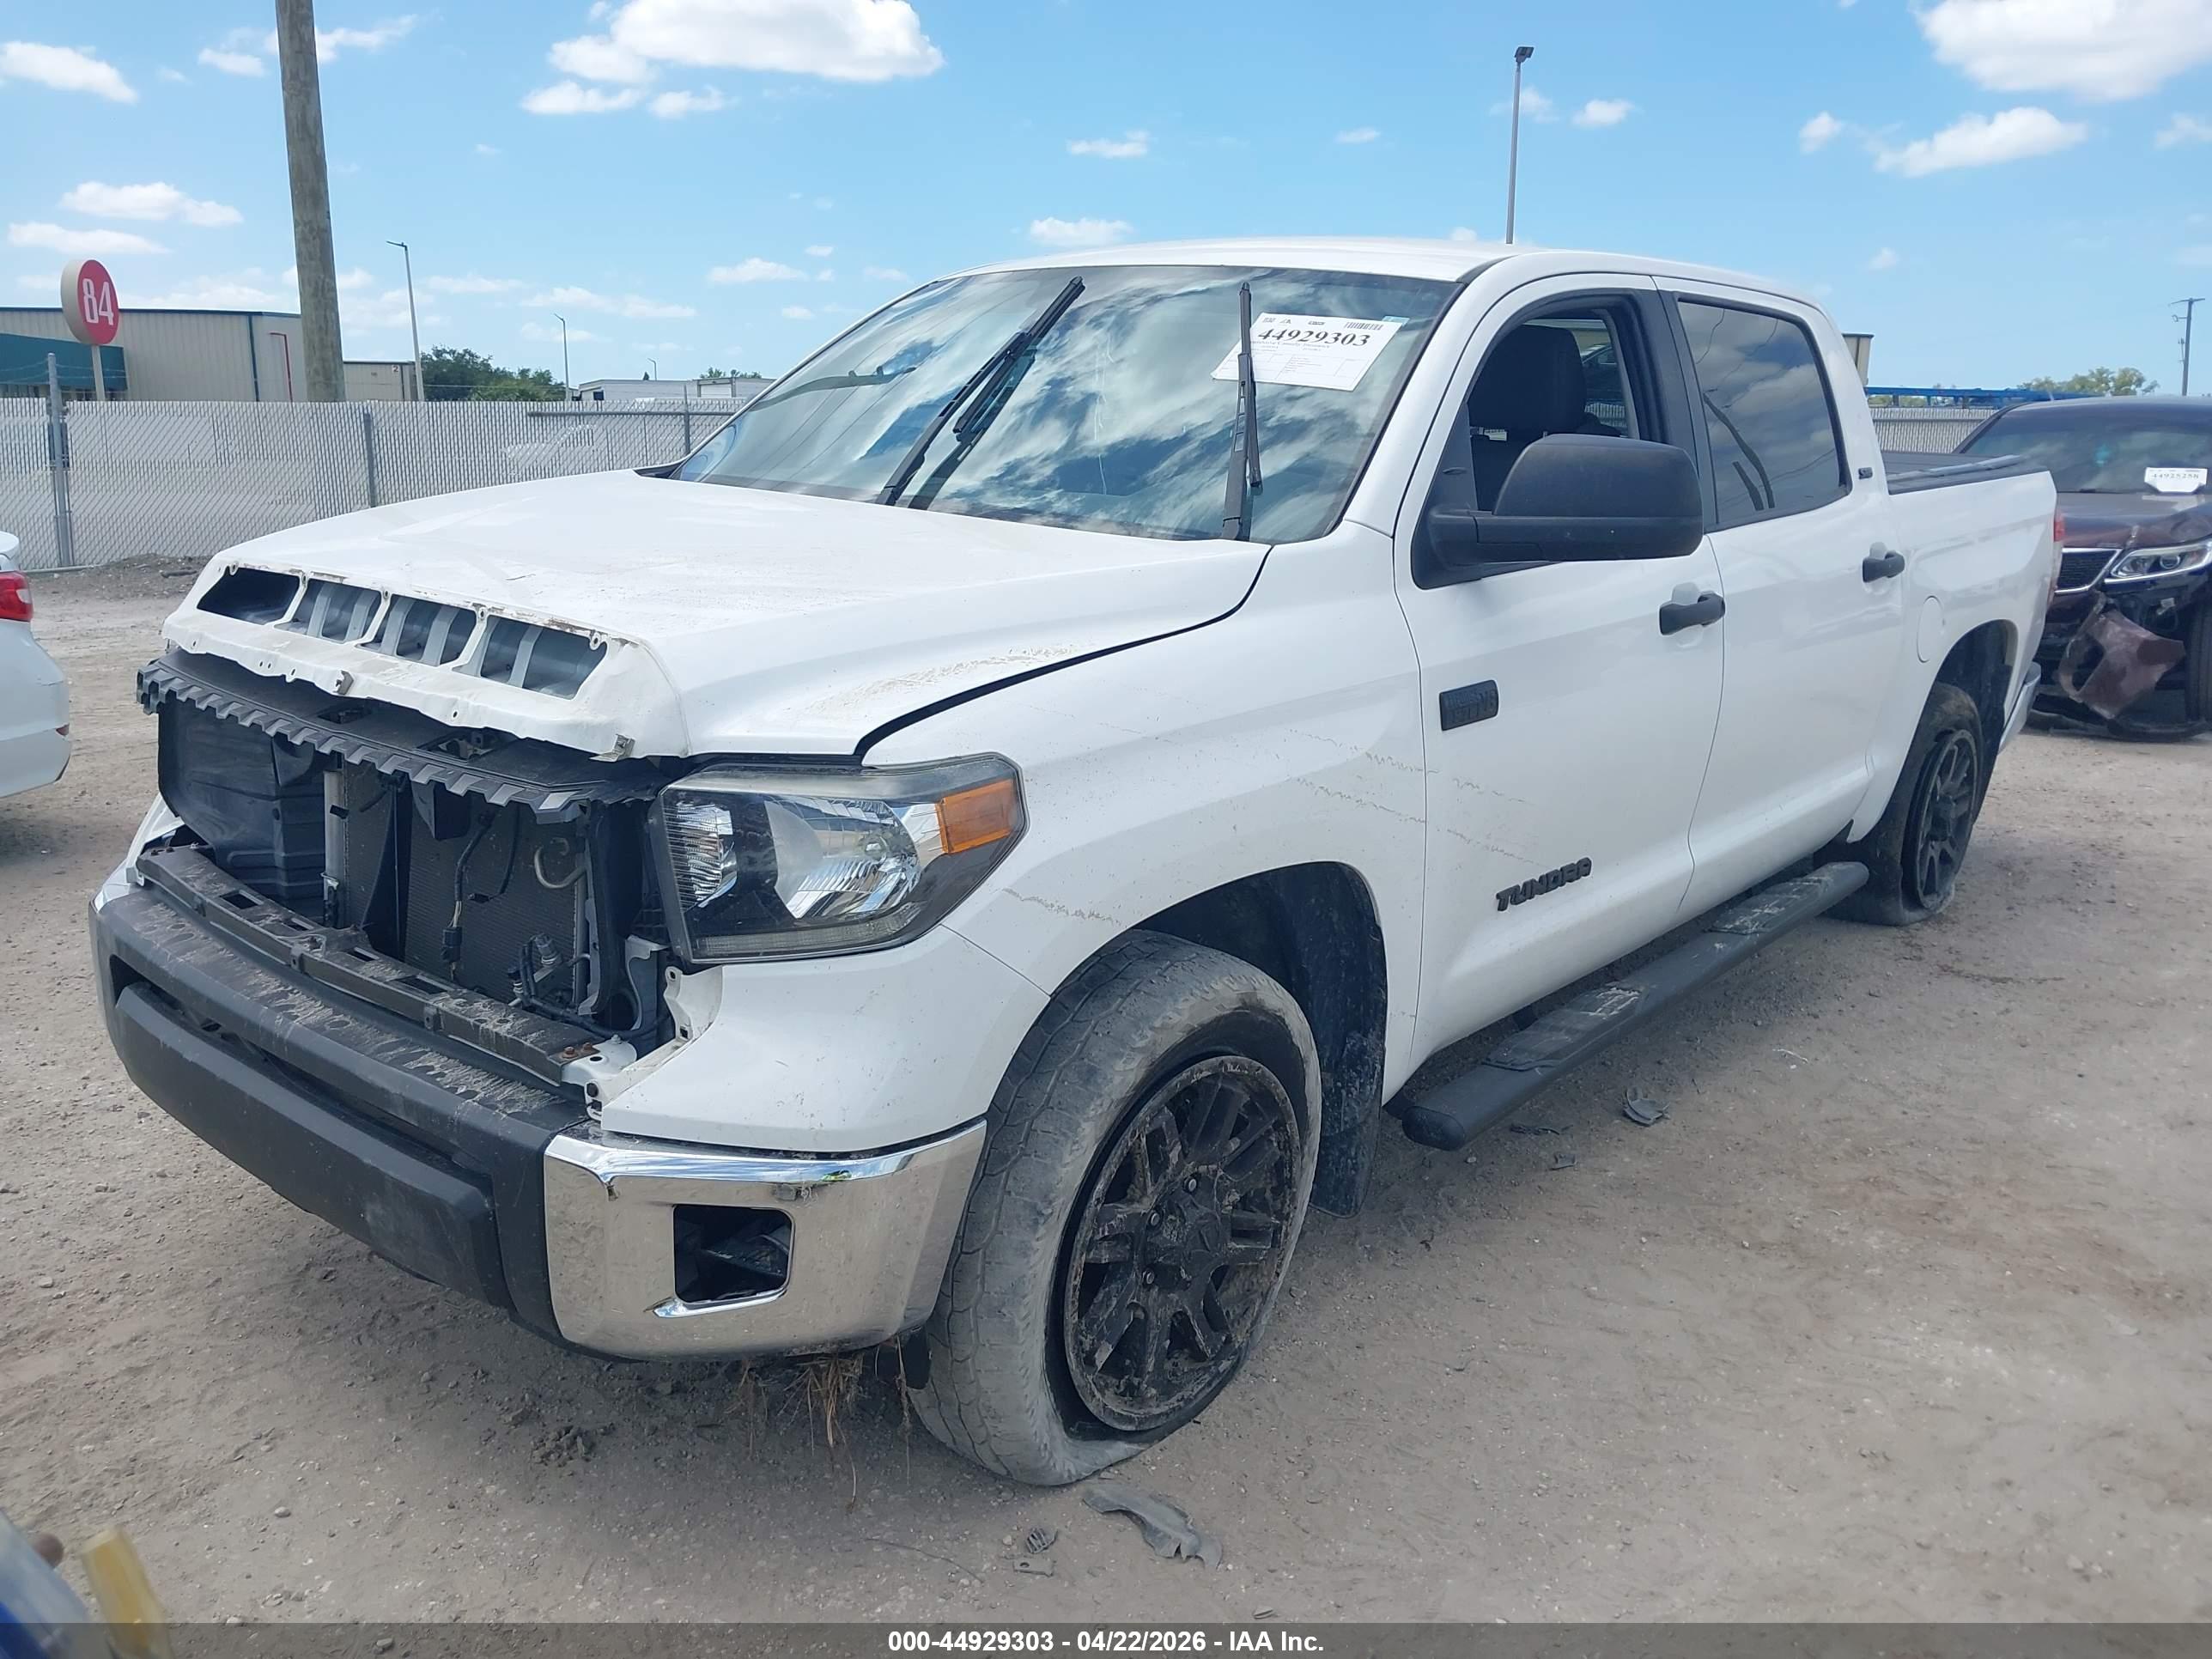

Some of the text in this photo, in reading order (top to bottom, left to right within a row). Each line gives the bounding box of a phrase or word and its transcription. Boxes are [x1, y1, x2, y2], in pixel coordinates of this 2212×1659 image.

[82, 277, 114, 326] 84
[1257, 327, 1372, 347] 44929303
[1495, 857, 1593, 912] TUNDRA
